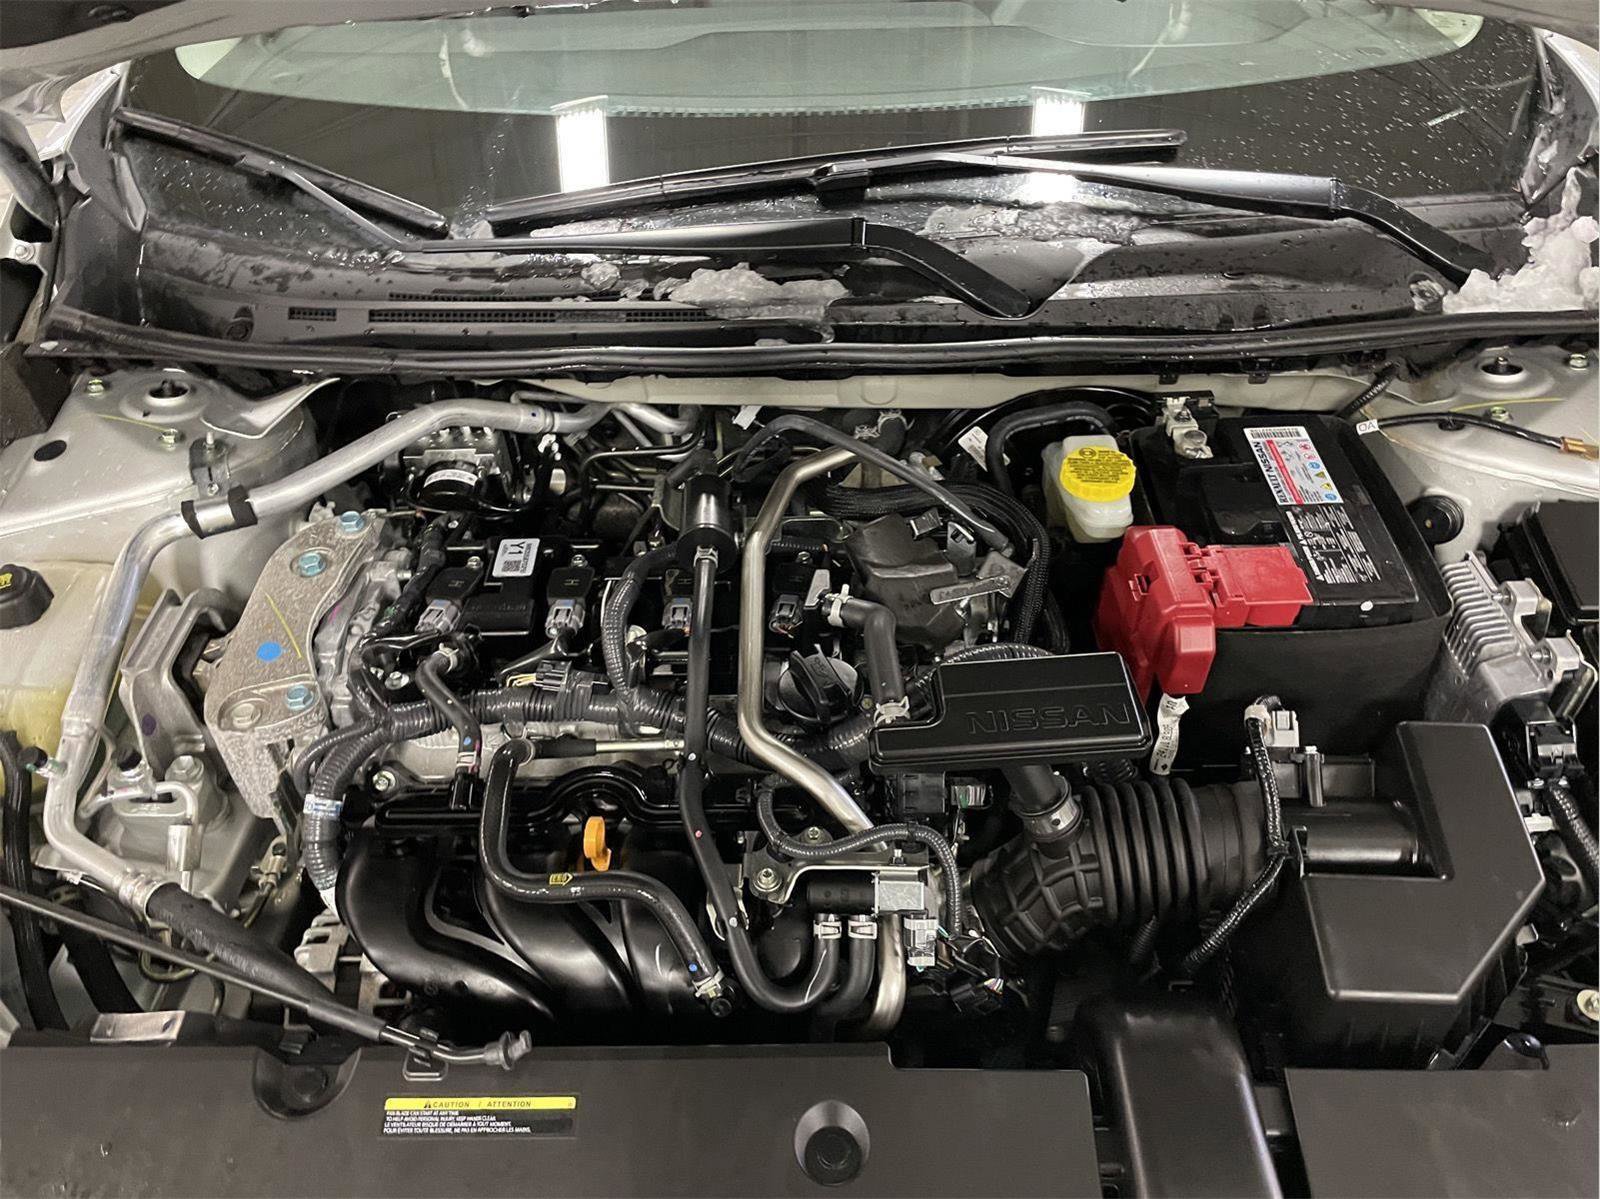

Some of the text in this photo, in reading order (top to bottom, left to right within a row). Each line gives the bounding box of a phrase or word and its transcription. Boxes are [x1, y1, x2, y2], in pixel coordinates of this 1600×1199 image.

[1253, 442, 1274, 472] NISSAN
[1268, 472, 1289, 503] RENAULT
[508, 540, 526, 554] Y1
[966, 703, 1130, 734] NISSAN
